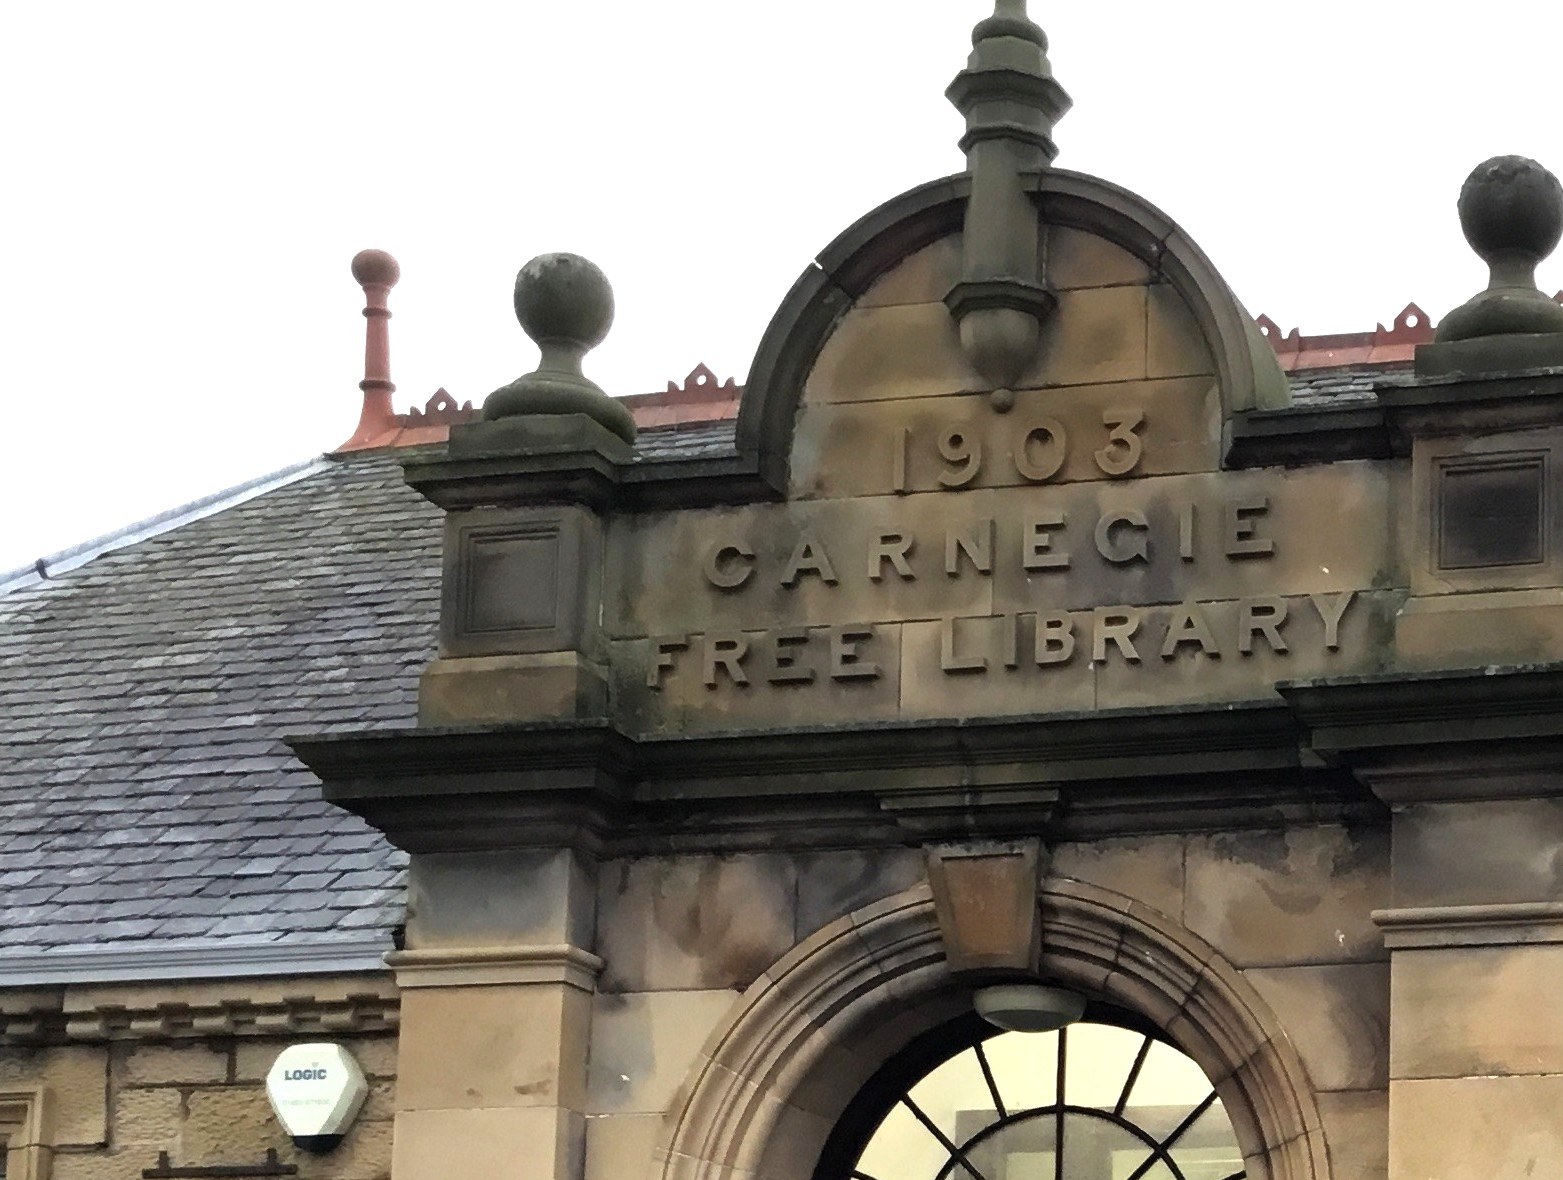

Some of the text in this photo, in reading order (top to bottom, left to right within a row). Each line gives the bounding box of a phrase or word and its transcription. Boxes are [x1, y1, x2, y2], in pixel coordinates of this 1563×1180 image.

[893, 408, 1145, 491] 1903
[702, 497, 1277, 588] CARNEGIE
[643, 590, 1360, 692] FREE LIBRARY
[284, 1069, 327, 1081] LOGIC
